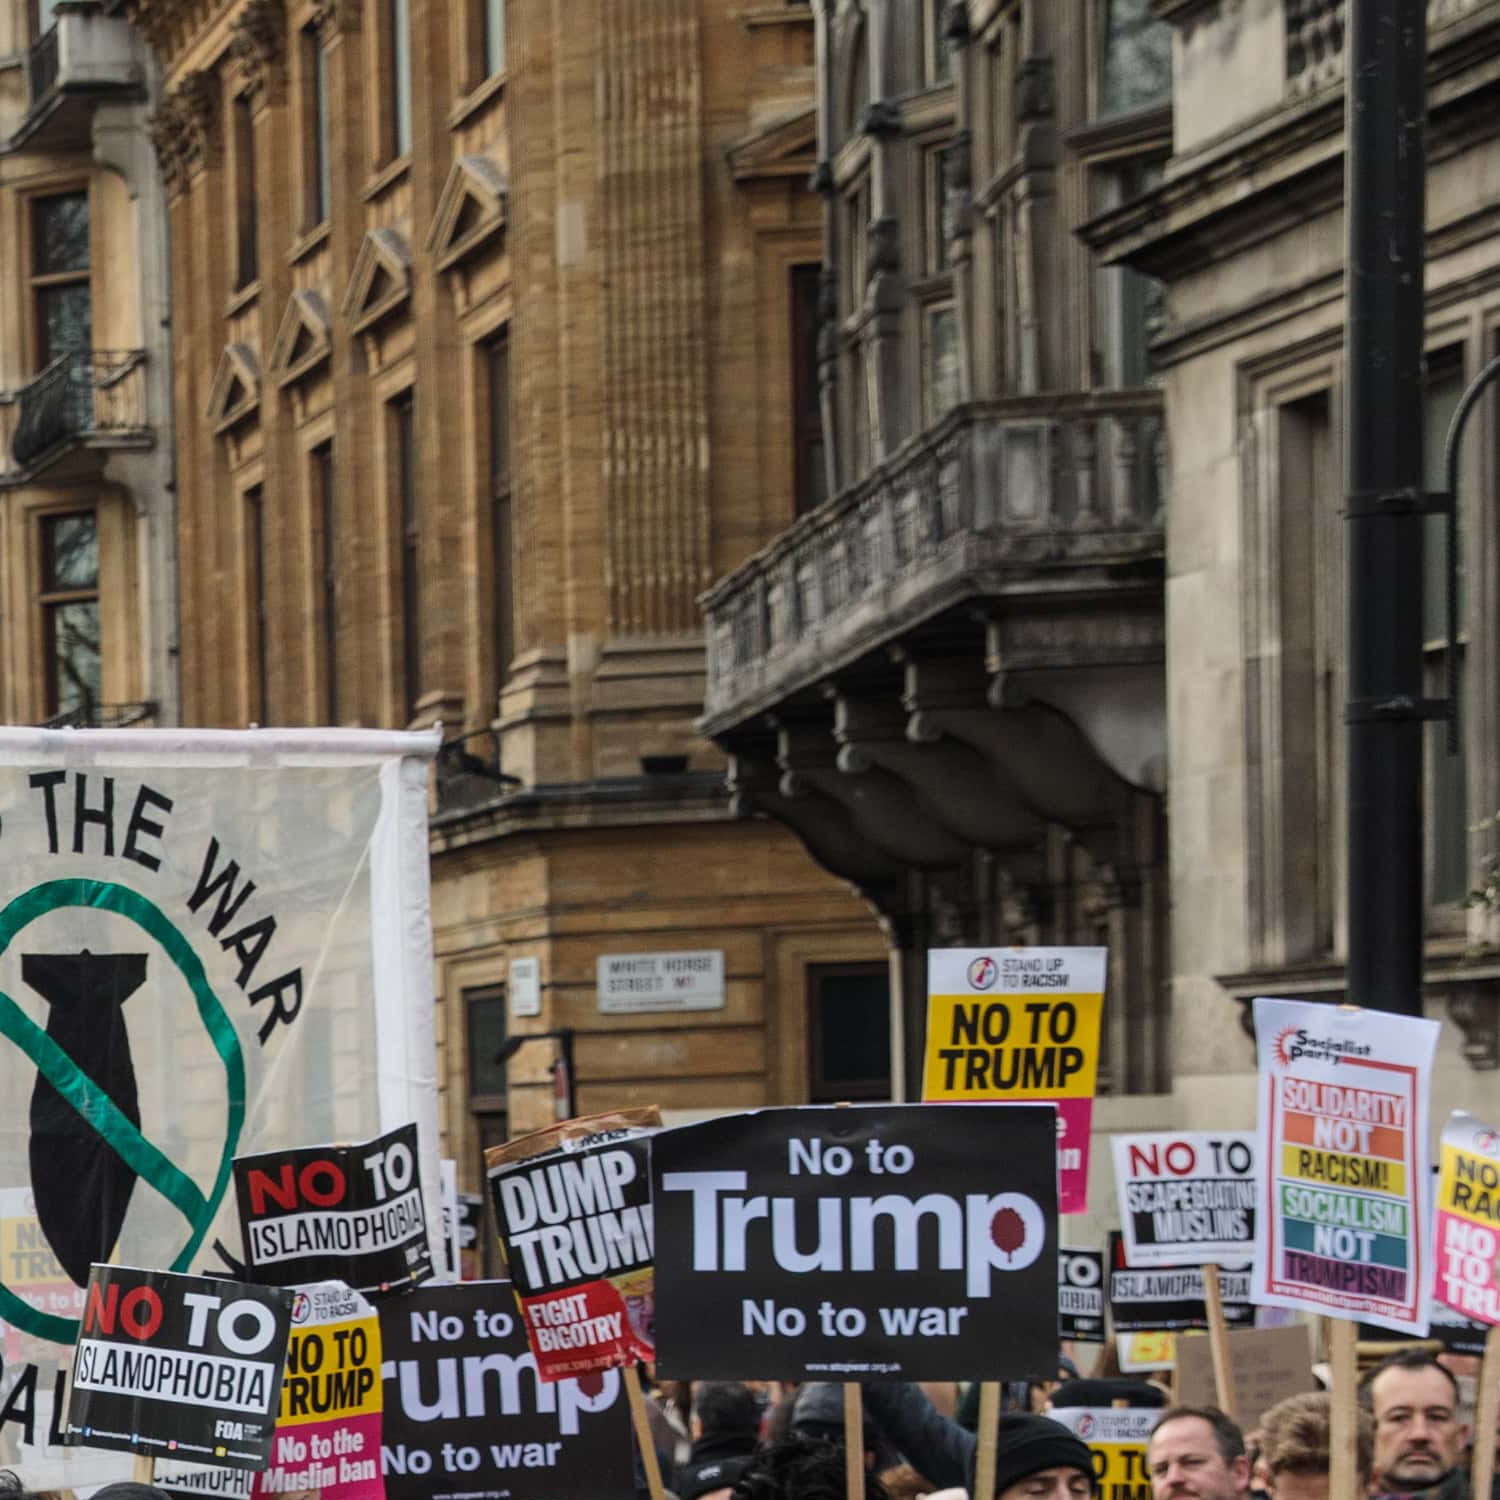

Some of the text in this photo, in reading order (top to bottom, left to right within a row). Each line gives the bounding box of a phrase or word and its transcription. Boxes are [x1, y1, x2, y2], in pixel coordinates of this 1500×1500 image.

[30, 771, 172, 872] THE
[187, 838, 303, 1045] WAR
[1003, 959, 1043, 972] STAND
[1021, 974, 1069, 987] RACISM
[952, 1002, 1076, 1045] NO TO
[1295, 1028, 1371, 1056] Socialist
[938, 1047, 1083, 1091] TRUMP
[1283, 1079, 1406, 1127] SOLIDARITY
[1313, 1117, 1375, 1153] NOT
[788, 1137, 914, 1175] No to
[1129, 1141, 1252, 1177] NO TO
[1298, 1149, 1389, 1190] RACISM!
[1456, 1155, 1500, 1189] NO
[248, 1142, 413, 1215] NO TO
[500, 1150, 636, 1234] DUMP
[253, 1197, 422, 1259] ISLAMOPHOBIA
[1153, 1210, 1248, 1241] MUSLIMS
[1284, 1187, 1402, 1235] SOCIALISM
[662, 1170, 1046, 1298] Trump
[1313, 1226, 1376, 1262] NOT
[1445, 1218, 1496, 1258] NO
[1284, 1251, 1406, 1301] TRUMPISM!
[1443, 1248, 1490, 1286] TO
[84, 1281, 276, 1355] NO TO
[411, 1309, 514, 1342] No to
[527, 1292, 588, 1327] FIGHT
[742, 1300, 968, 1337] No to war
[287, 1327, 367, 1374] NO TO
[536, 1312, 623, 1352] BIGOTRY
[75, 1344, 265, 1408] ISLAMOPHOBIA
[215, 1420, 243, 1440] FOA
[277, 1437, 306, 1463] No
[311, 1434, 330, 1459] to
[330, 1428, 364, 1455] the
[261, 1460, 336, 1494] Muslim
[340, 1457, 377, 1482] ban
[381, 1442, 562, 1475] No to war
